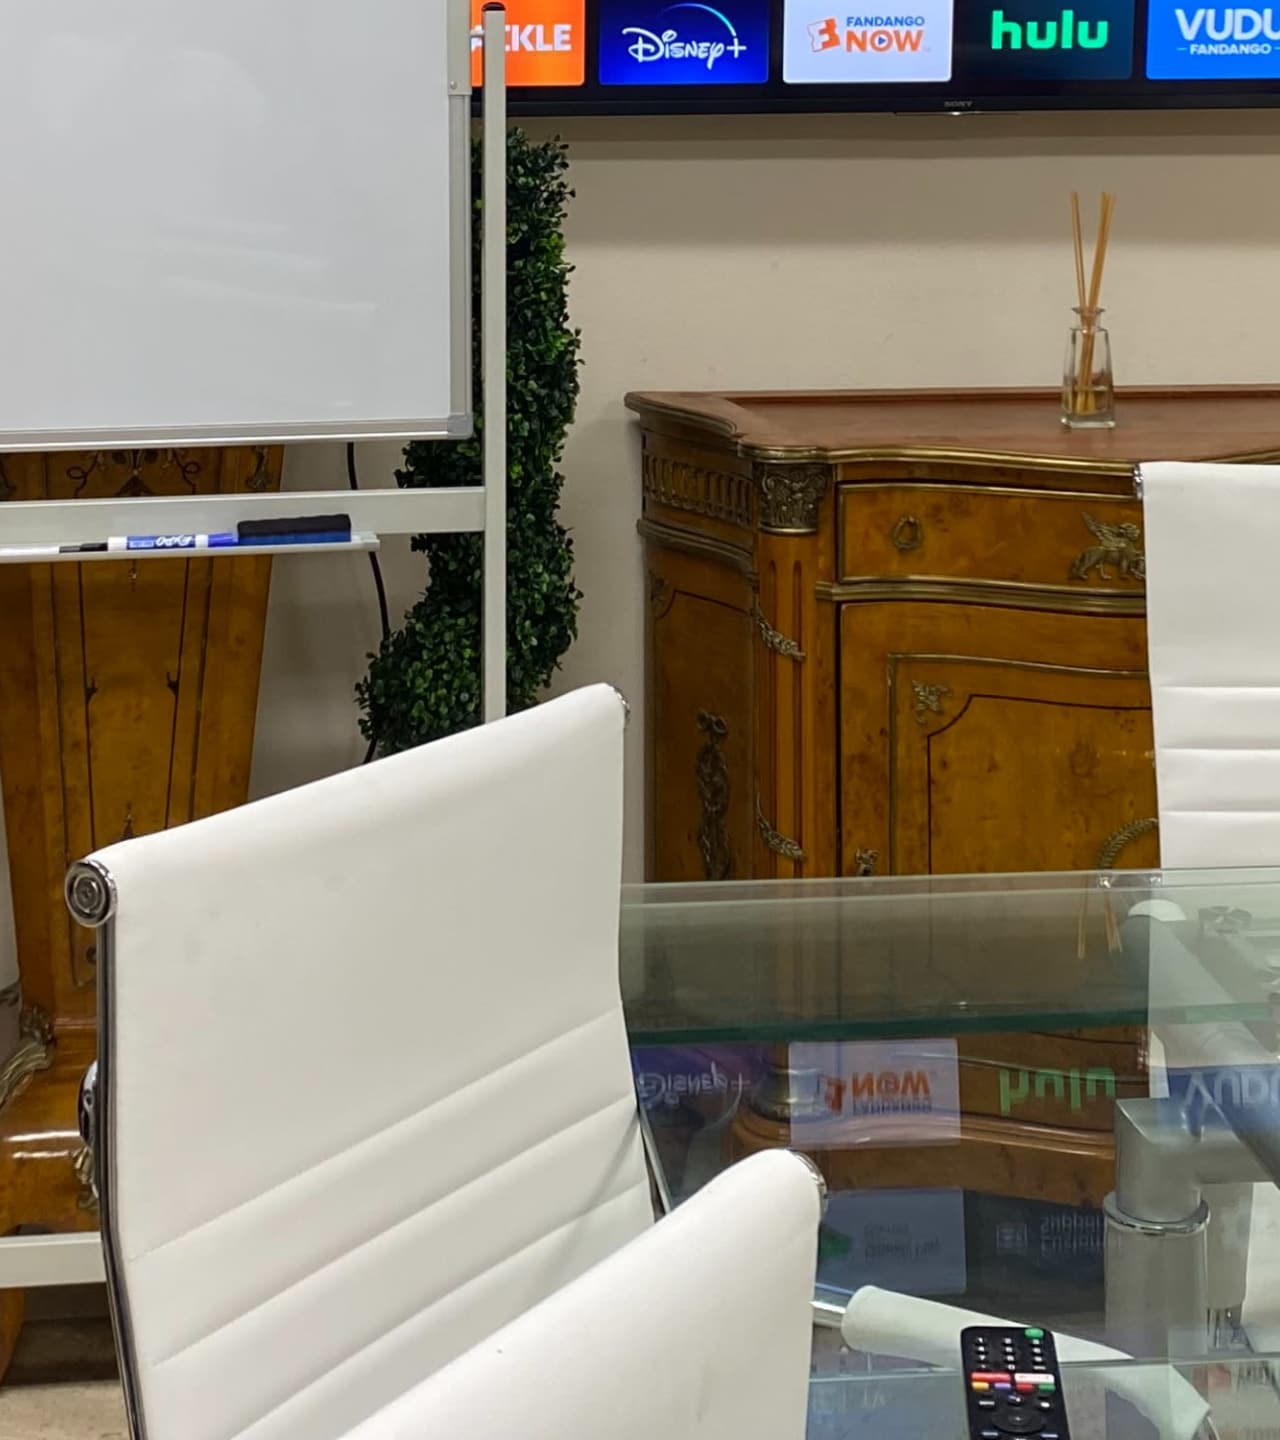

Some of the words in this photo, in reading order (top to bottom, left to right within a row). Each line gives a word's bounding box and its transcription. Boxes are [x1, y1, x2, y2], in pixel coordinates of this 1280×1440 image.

[847, 16, 925, 27] FANDANGO
[992, 10, 1108, 49] hulu
[622, 24, 746, 69] Disney+
[846, 30, 923, 52] NOW
[1190, 43, 1272, 55] FANDANGO
